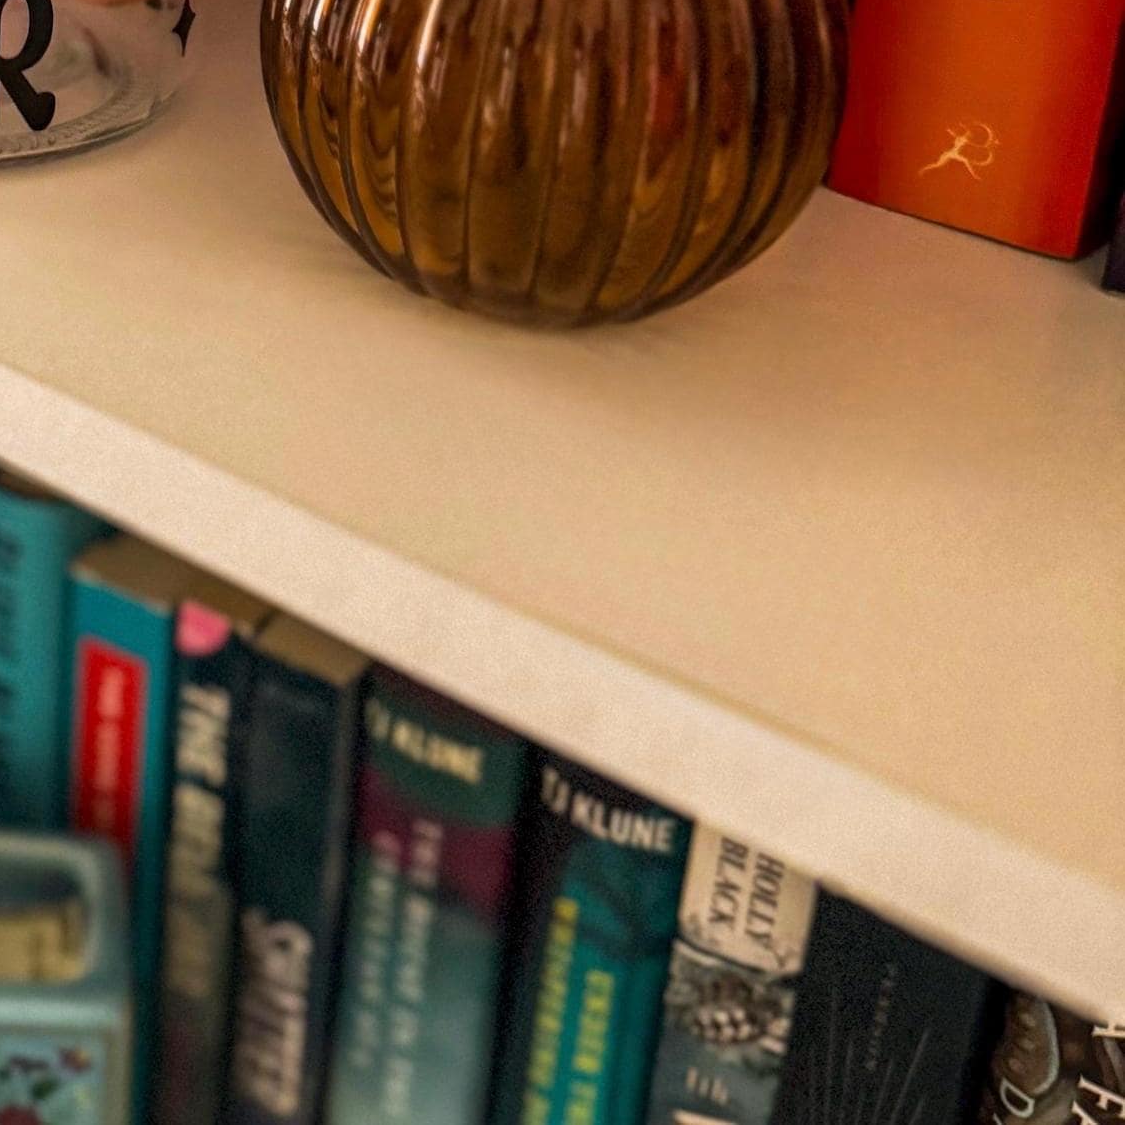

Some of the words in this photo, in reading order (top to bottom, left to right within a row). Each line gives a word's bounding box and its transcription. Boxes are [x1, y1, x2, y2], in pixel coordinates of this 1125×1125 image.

[571, 788, 674, 855] KLUNE
[707, 836, 748, 932] BLACK
[743, 851, 786, 949] HOLLY
